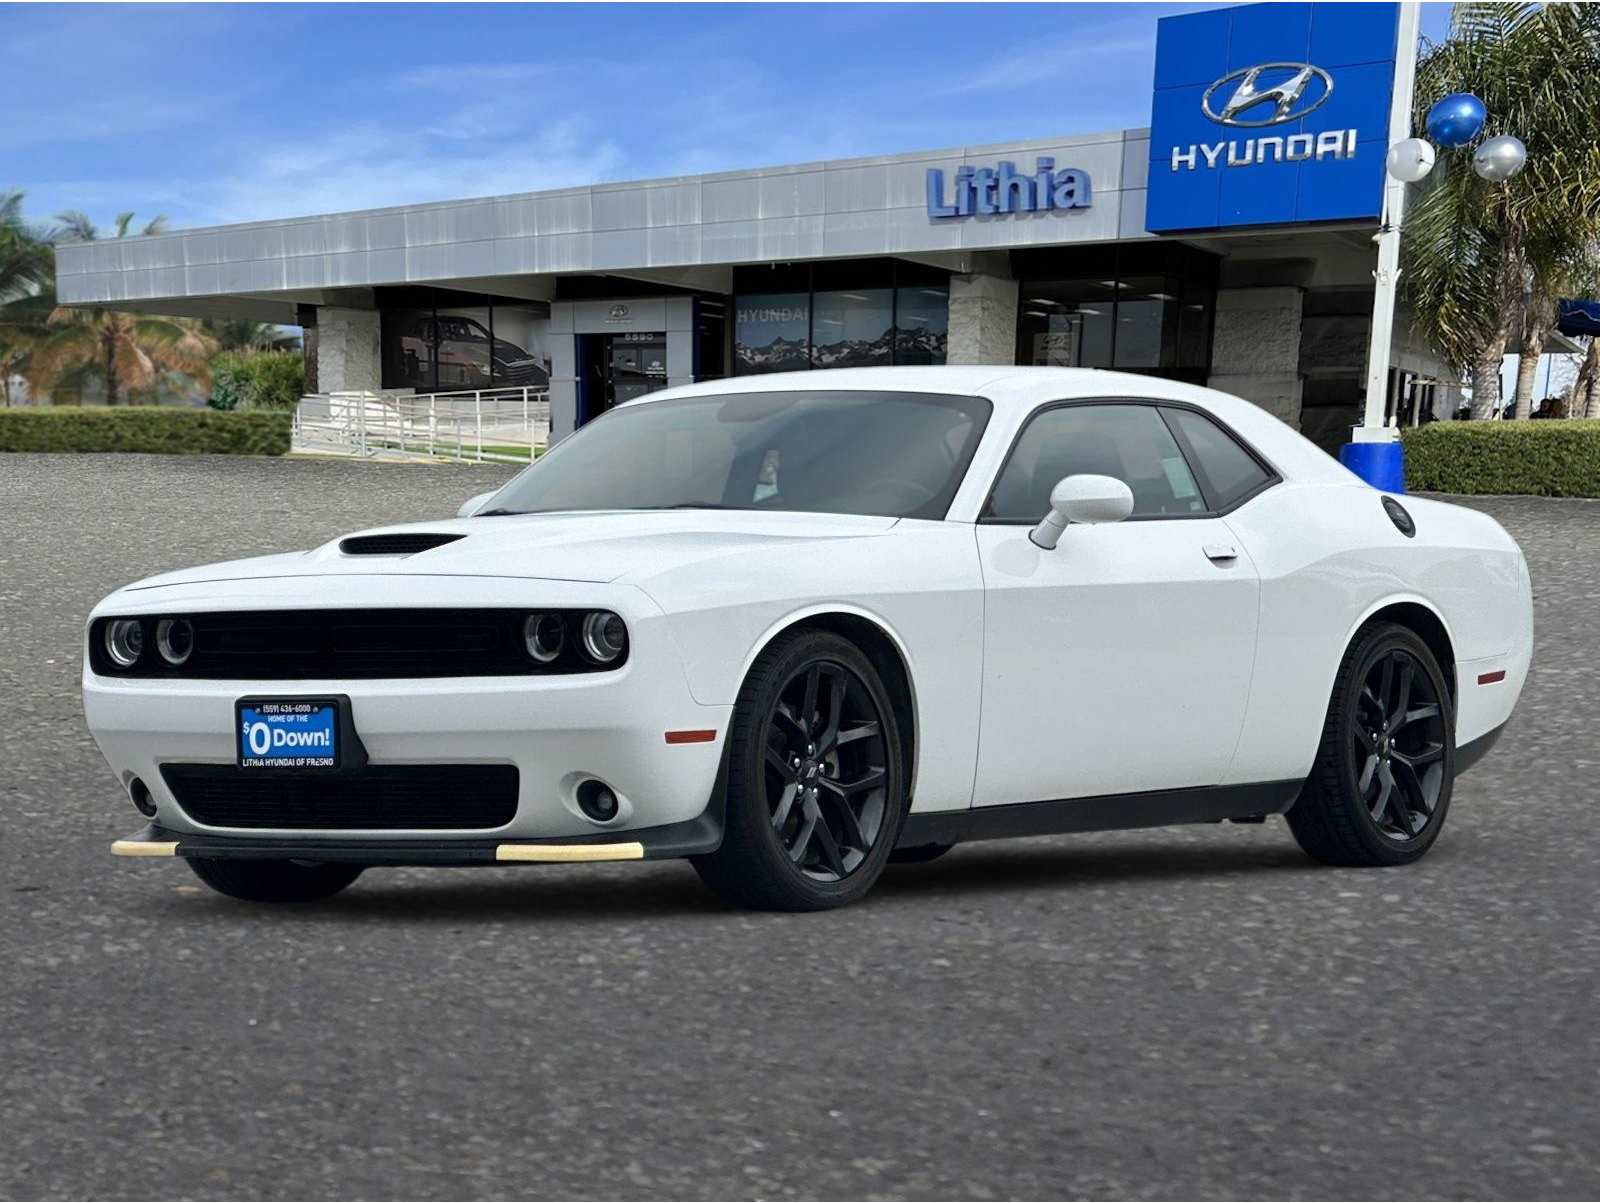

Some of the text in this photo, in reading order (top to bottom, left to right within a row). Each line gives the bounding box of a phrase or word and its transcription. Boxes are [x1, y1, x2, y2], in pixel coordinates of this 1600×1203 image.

[1171, 129, 1357, 172] HYUNDAI
[926, 157, 1092, 218] Lithia
[737, 307, 809, 322] HYUNDAI
[267, 714, 309, 722] HOME OF THE
[273, 728, 330, 747] Down!
[242, 758, 264, 767] LITHIA
[265, 758, 295, 767] HYUNDAI
[296, 758, 305, 766] OF
